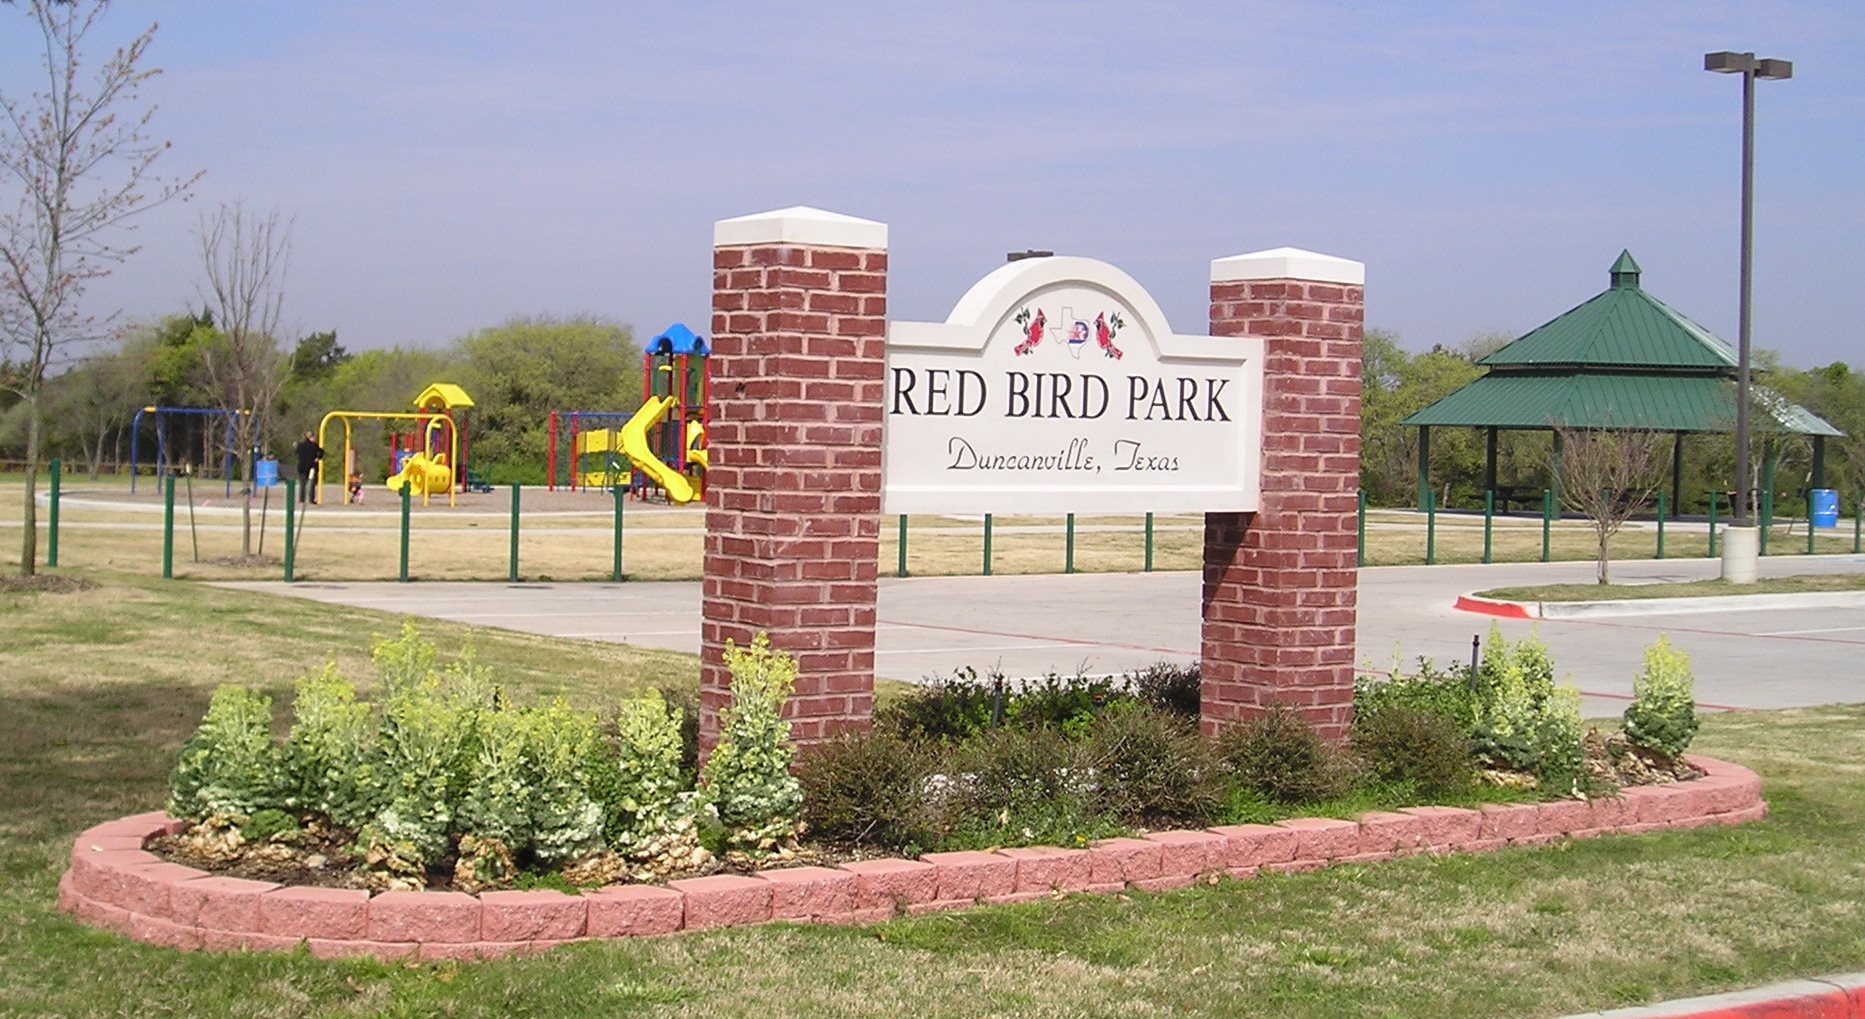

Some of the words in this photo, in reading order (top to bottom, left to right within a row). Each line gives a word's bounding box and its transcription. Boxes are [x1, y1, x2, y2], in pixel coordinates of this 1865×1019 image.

[889, 367, 987, 417] RED
[1004, 371, 1110, 420] BIRD
[1125, 375, 1232, 422] PARK
[947, 436, 1102, 474] Duncanville,
[1114, 439, 1180, 471] Texas
